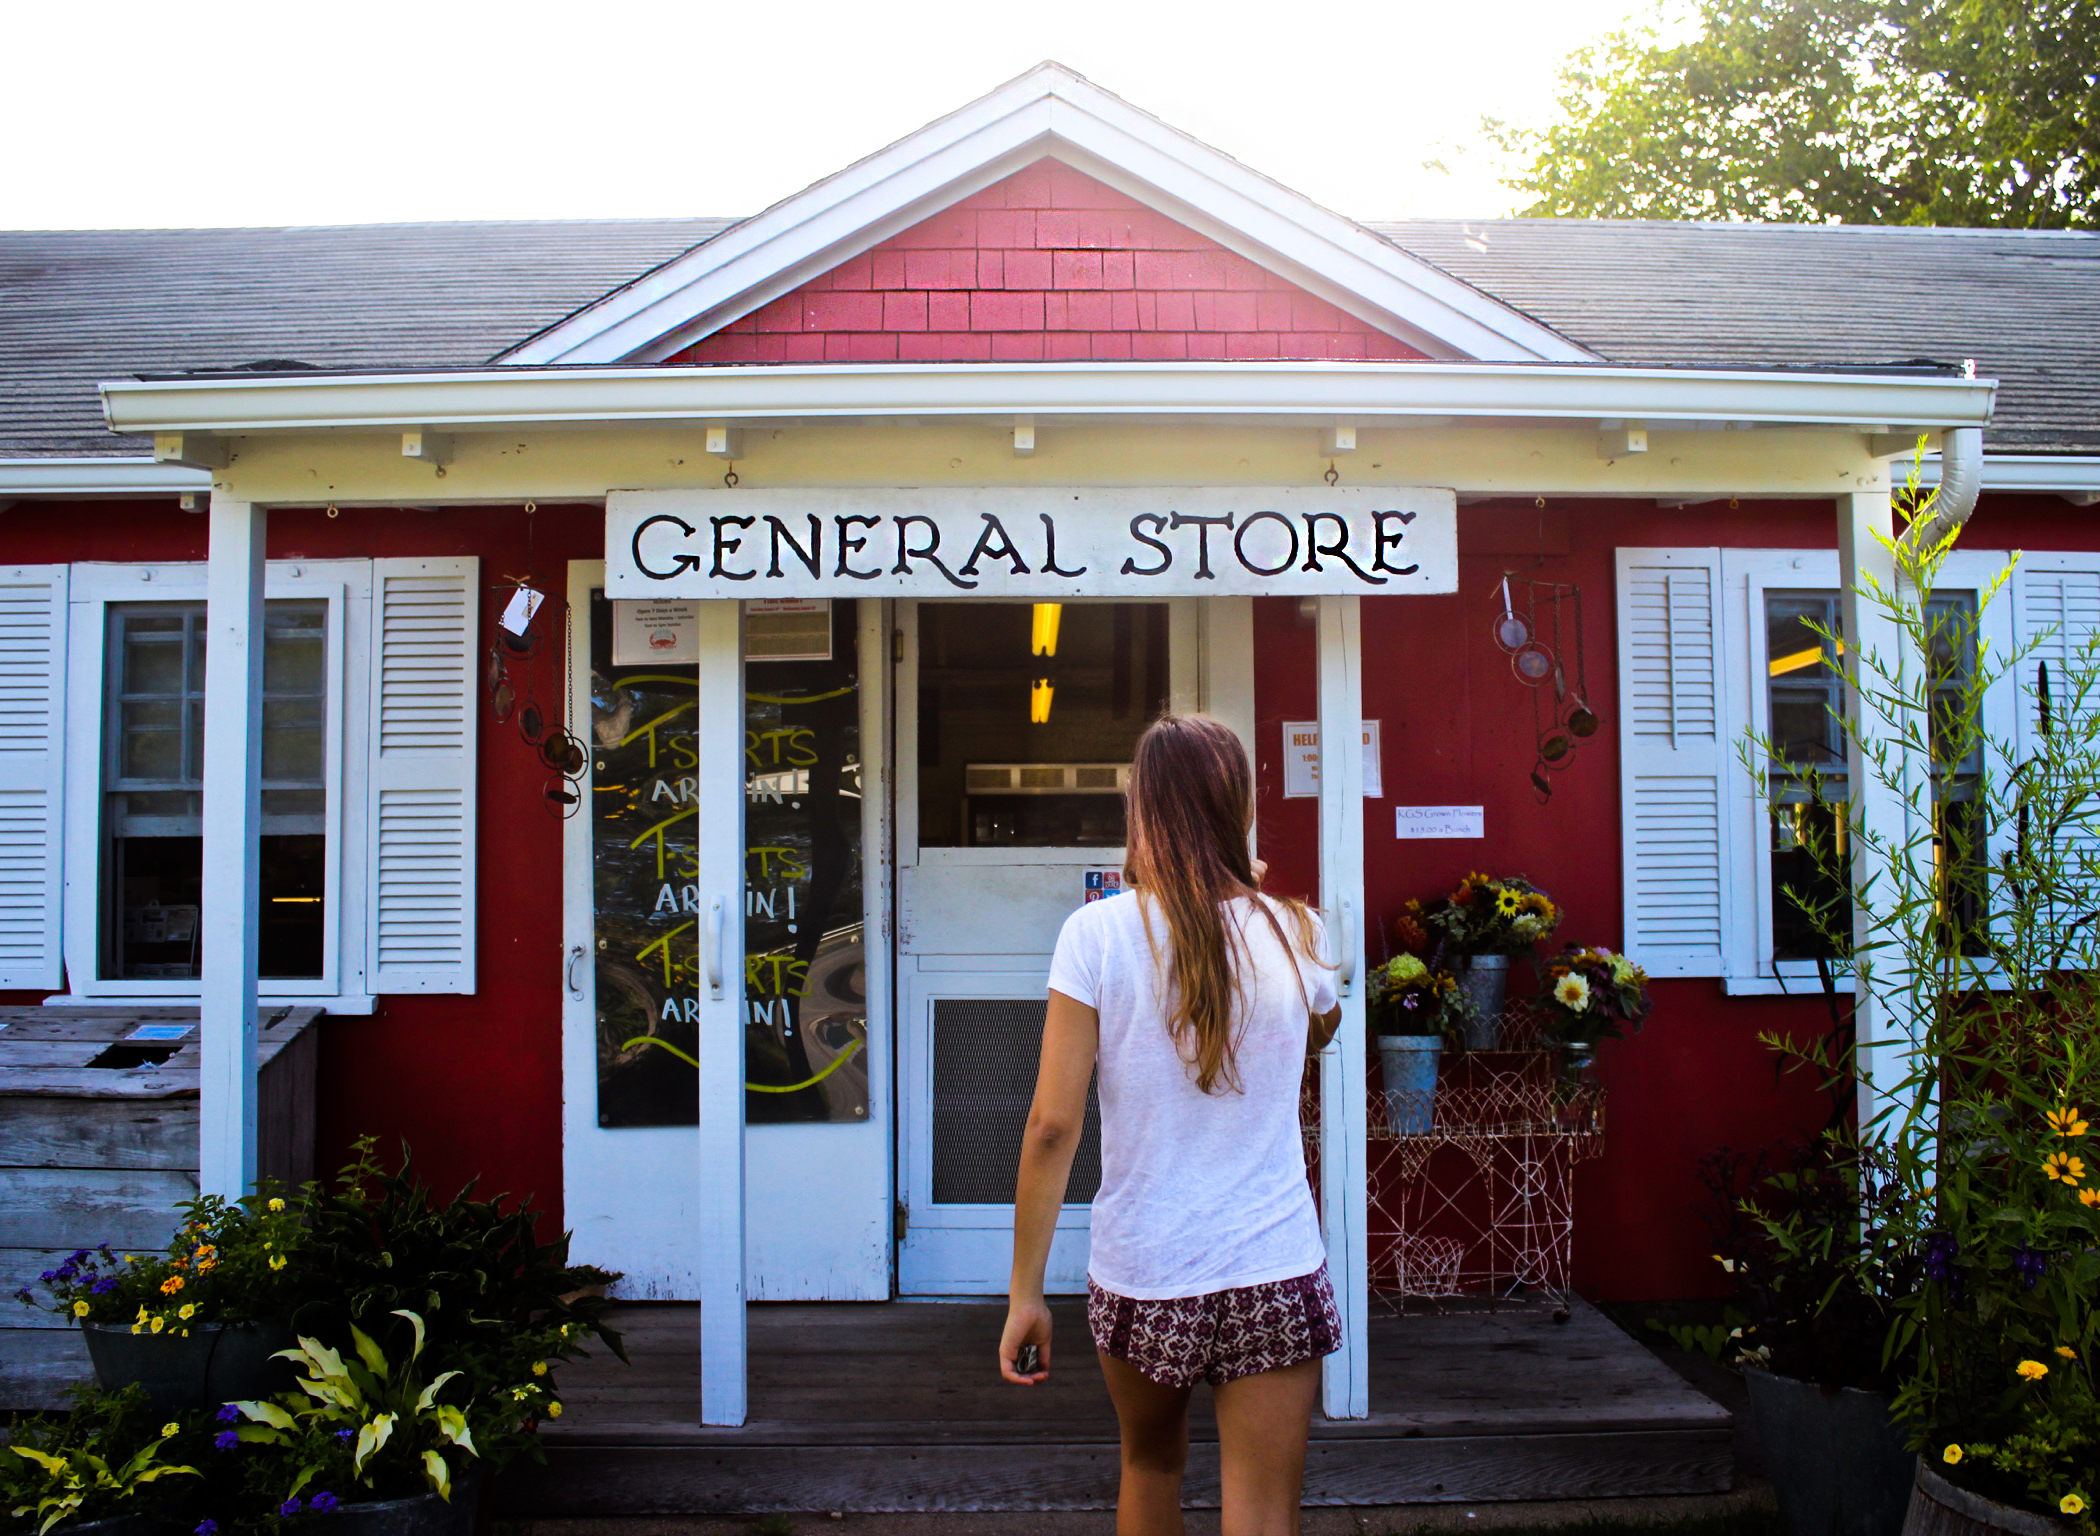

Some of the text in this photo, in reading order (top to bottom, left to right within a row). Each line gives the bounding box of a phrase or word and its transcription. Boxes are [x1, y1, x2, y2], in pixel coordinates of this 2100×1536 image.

[631, 510, 1420, 589] GENERAL STORE
[620, 701, 819, 768] T-SRTS
[651, 777, 699, 804] AR
[1397, 808, 1423, 819] KGS
[1445, 824, 1471, 834] Bunch
[655, 883, 699, 914] AR
[661, 998, 699, 1024] AR
